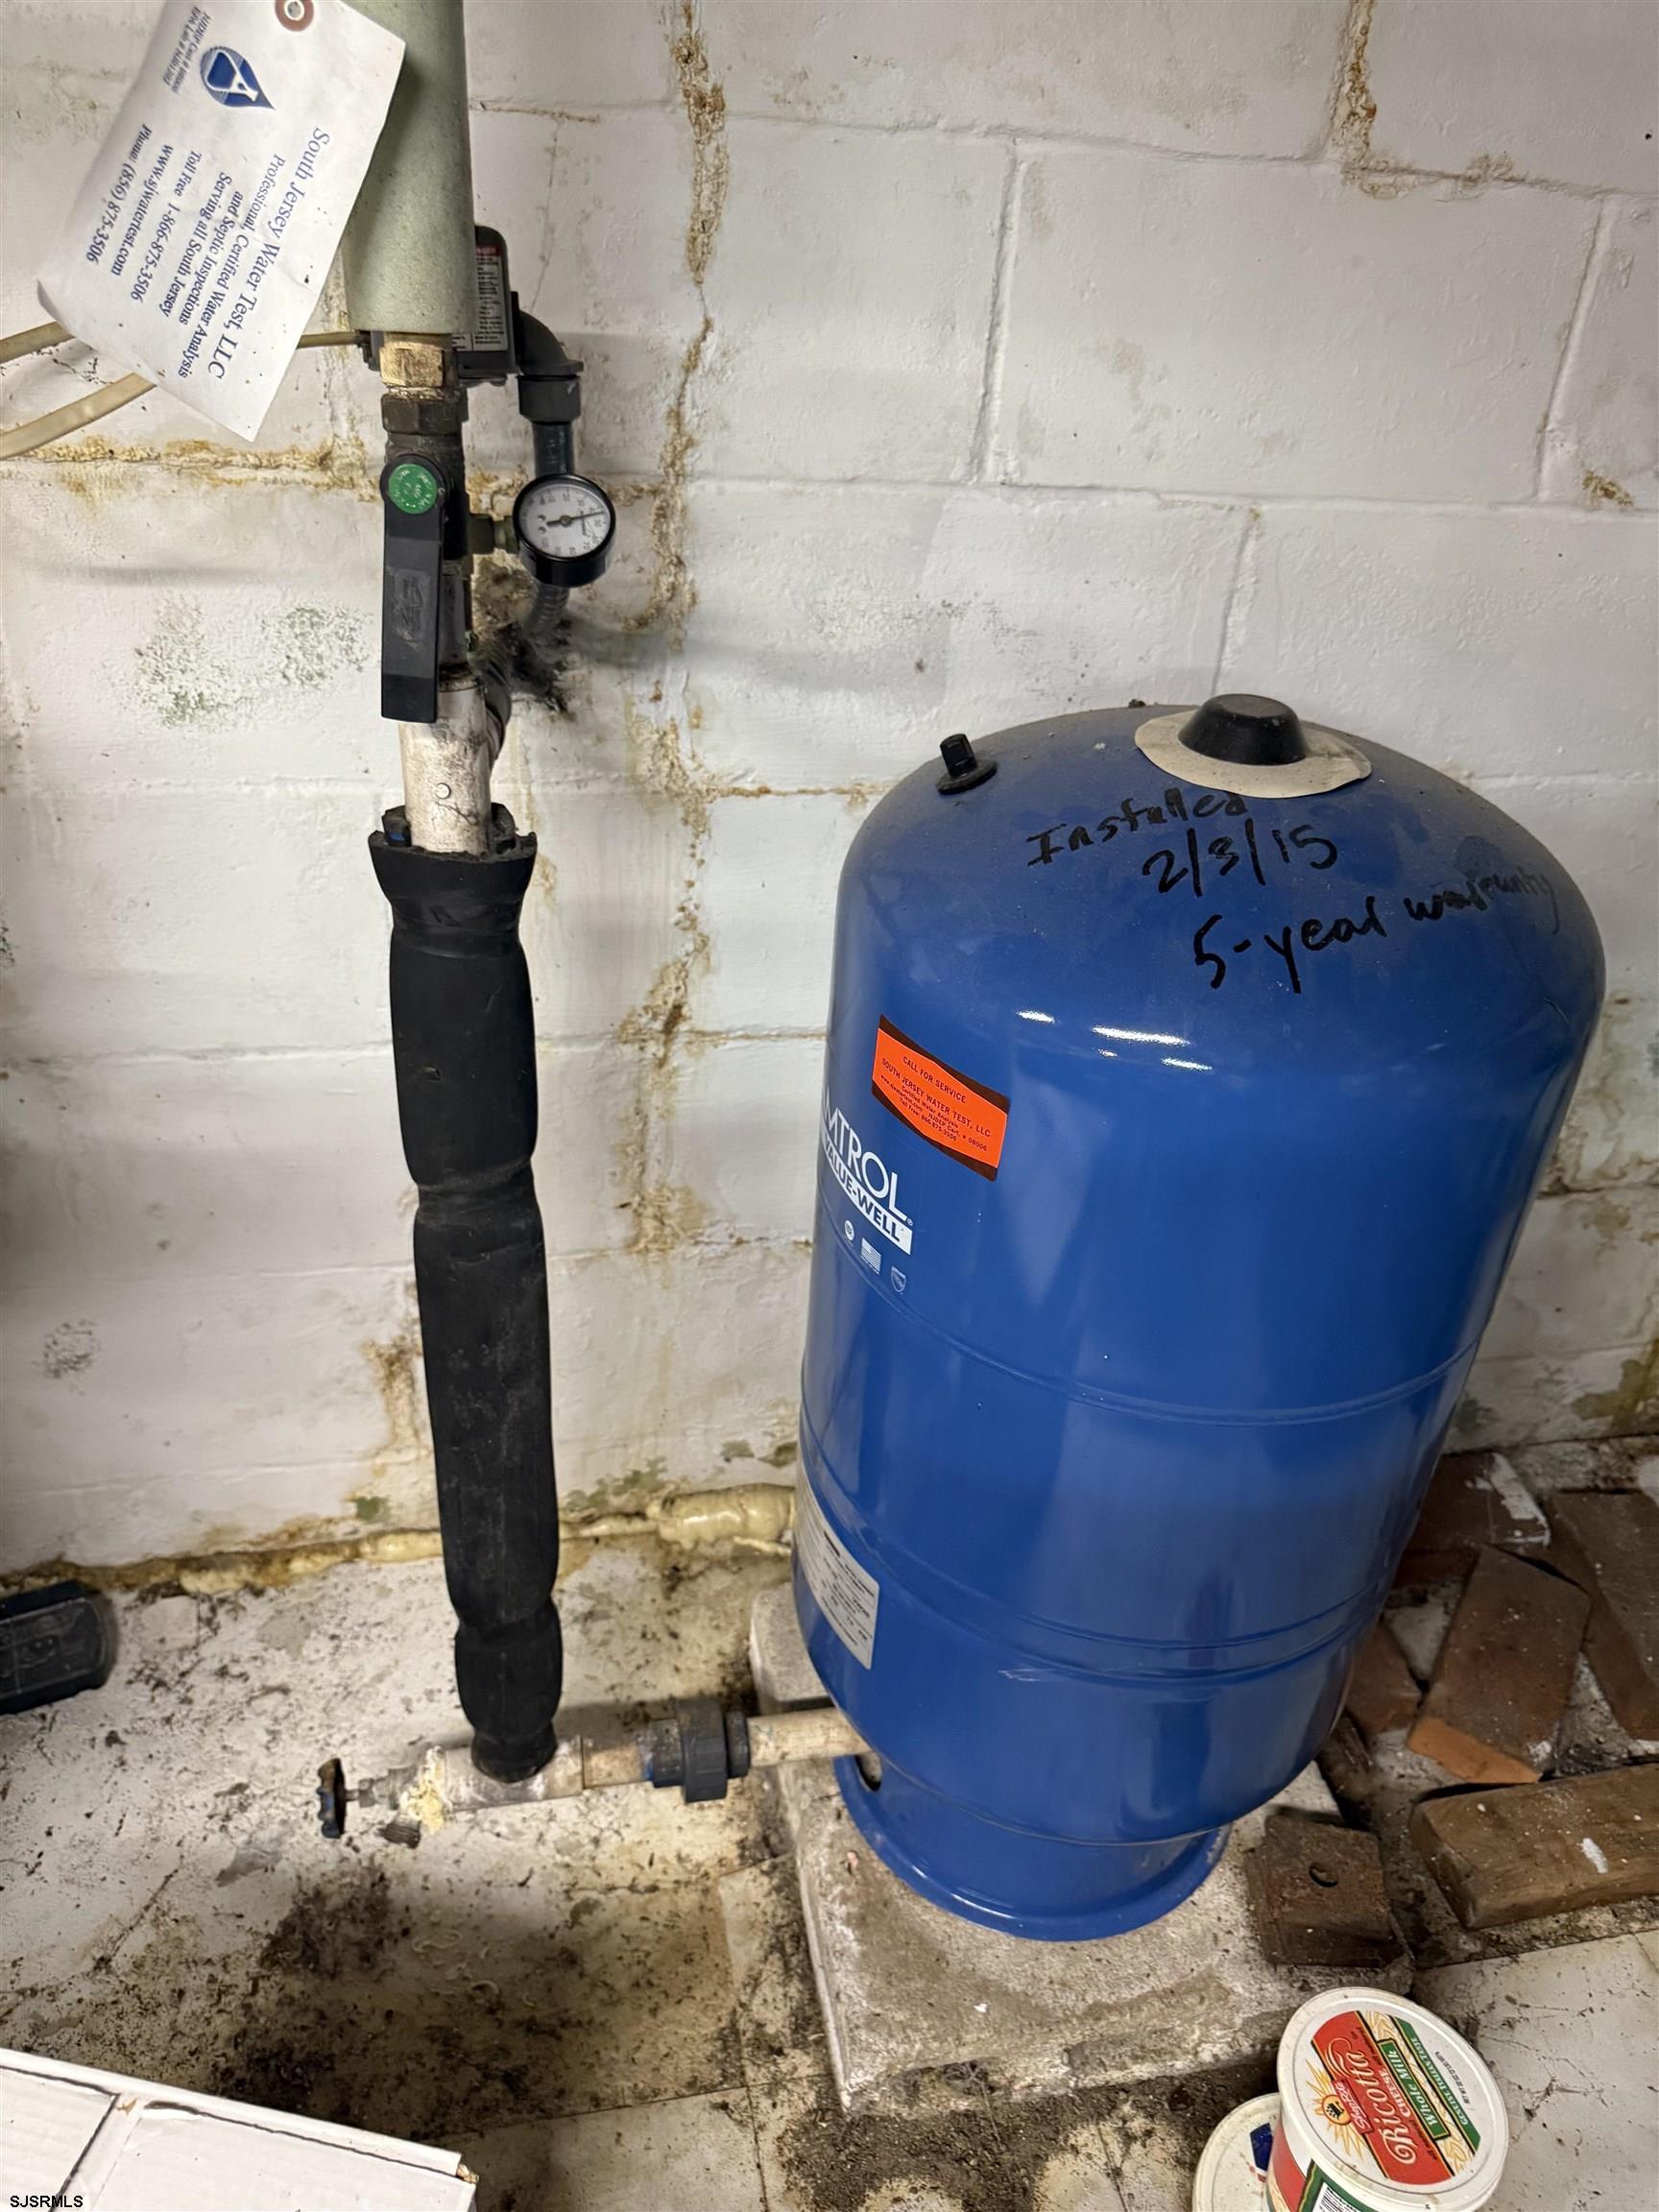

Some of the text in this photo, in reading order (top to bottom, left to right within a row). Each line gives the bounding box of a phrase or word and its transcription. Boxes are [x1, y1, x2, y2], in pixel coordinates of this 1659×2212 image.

[110, 163, 135, 201] (856)
[111, 145, 173, 276] www.sjwatertest.com
[131, 151, 202, 301] Toll Free 1-866-875-3506
[86, 201, 120, 262] 875-3506
[158, 172, 232, 317] Serving all South Jersey
[178, 155, 285, 378] Professional, Certified Water Analysis
[179, 191, 243, 325] and Septic Inspections
[207, 128, 329, 379] South Jersey Water Test, LLC
[1142, 818, 1337, 897] 2/3/15
[1193, 896, 1387, 994] 5-year
[882, 1058, 901, 1079] SOUTH
[902, 1076, 925, 1096] JERSEY
[926, 1094, 950, 1115] WATER
[975, 1124, 991, 1138] LLC
[902, 1056, 966, 1104] CALL FOR SERVICE
[1340, 2053, 1416, 2164] Ricotta
[1379, 2067, 1410, 2117] CHEESE
[1388, 2051, 1437, 2126] Whole Milk
